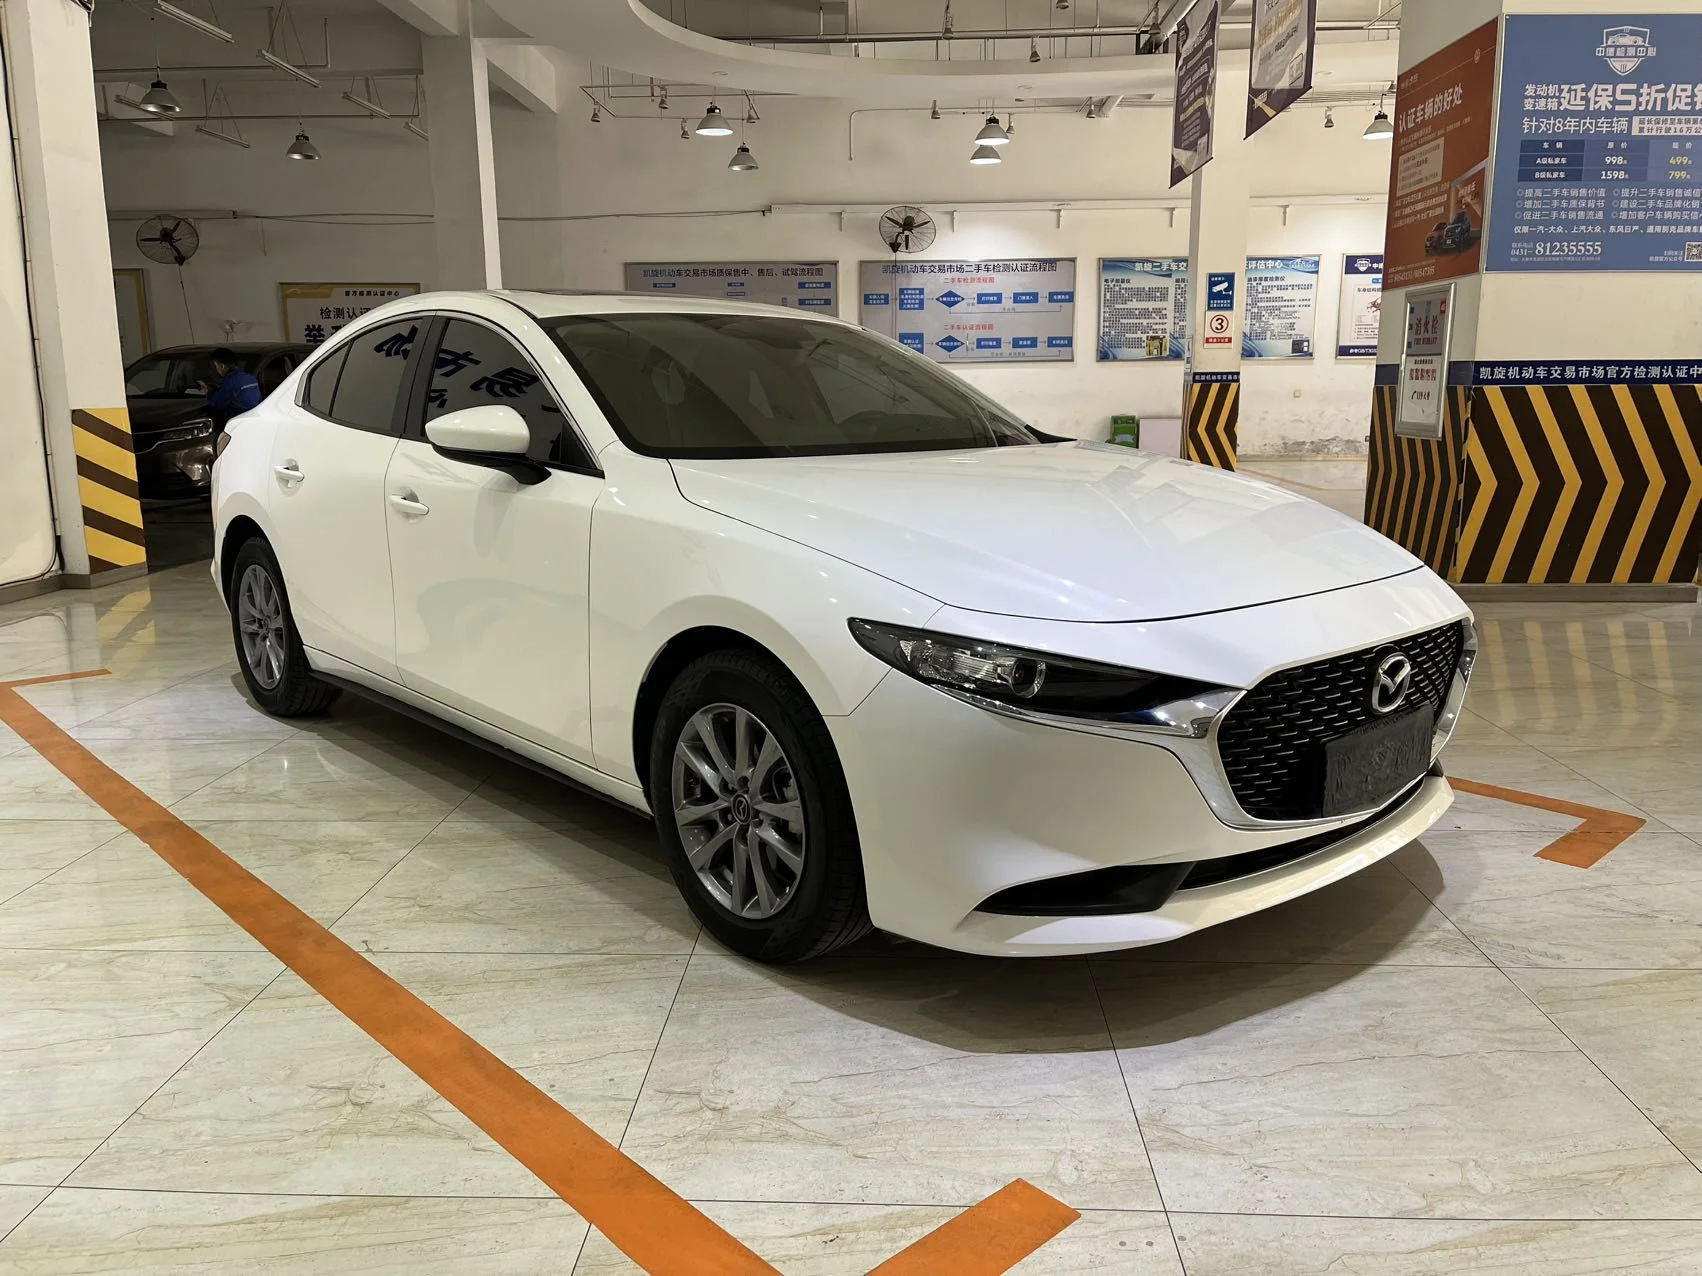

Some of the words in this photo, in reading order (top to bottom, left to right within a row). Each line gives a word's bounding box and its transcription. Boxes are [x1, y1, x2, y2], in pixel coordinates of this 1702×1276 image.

[1524, 84, 1559, 97] 发动机
[1399, 82, 1463, 133] 认证车辆的好处
[1523, 98, 1559, 111] 变速箱
[1522, 117, 1628, 134] 针对8年内车辆
[1536, 157, 1567, 165] A级私家车
[1525, 188, 1606, 197] 提高二手车销售价值
[1523, 199, 1605, 208] 增加二手车质保背书
[1619, 199, 1702, 208] 建设二手车品牌化销
[1523, 211, 1604, 220] 促进二手车销售流通
[1618, 211, 1702, 220] 增加客户车辆购买信
[1535, 241, 1602, 256] 81235555
[882, 263, 1057, 275] 凯旋机动车交易市场二手车检测认证流程图
[1215, 317, 1225, 331] 3
[1479, 365, 1702, 380] 凯旋机动车交易市场官方检测认证中
